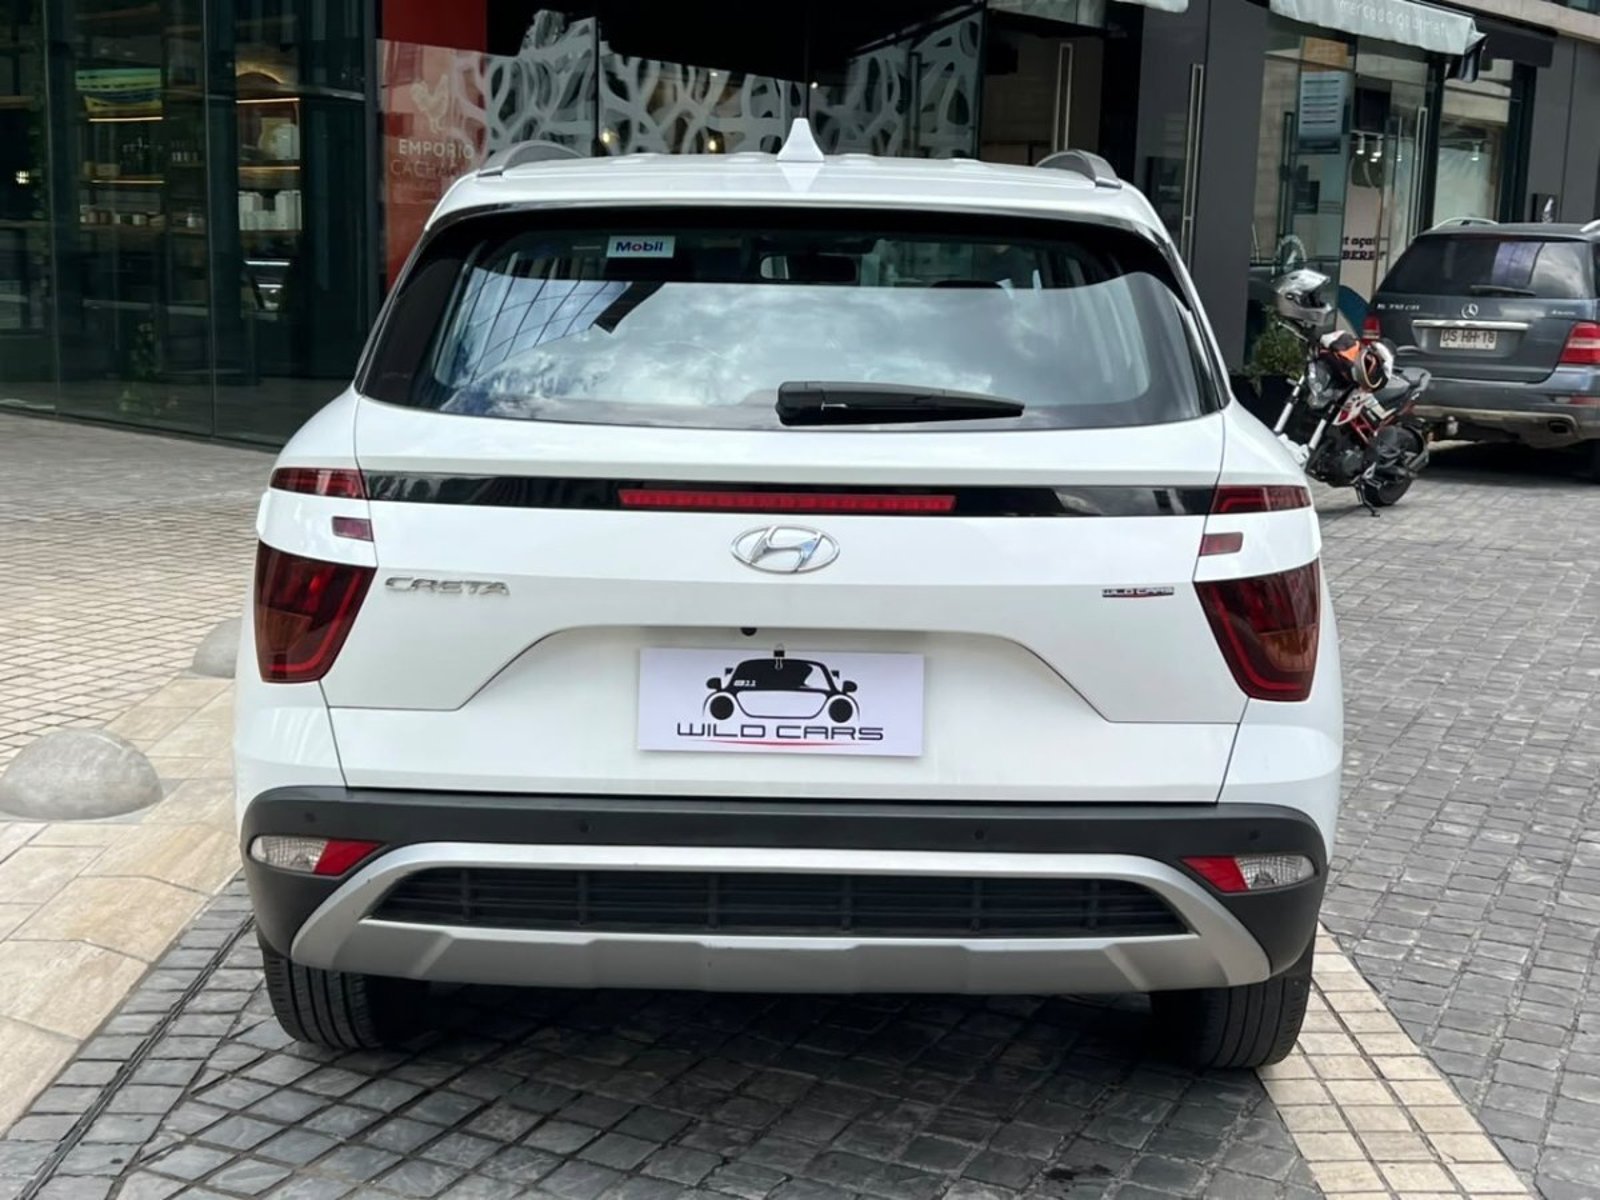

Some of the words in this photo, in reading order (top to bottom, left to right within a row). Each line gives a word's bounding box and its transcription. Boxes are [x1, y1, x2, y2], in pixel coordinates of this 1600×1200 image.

[398, 138, 475, 160] EMPORIO
[615, 241, 664, 252] Mobil
[384, 577, 510, 596] CRETA
[677, 722, 766, 738] WILD
[775, 725, 883, 741] CARS
